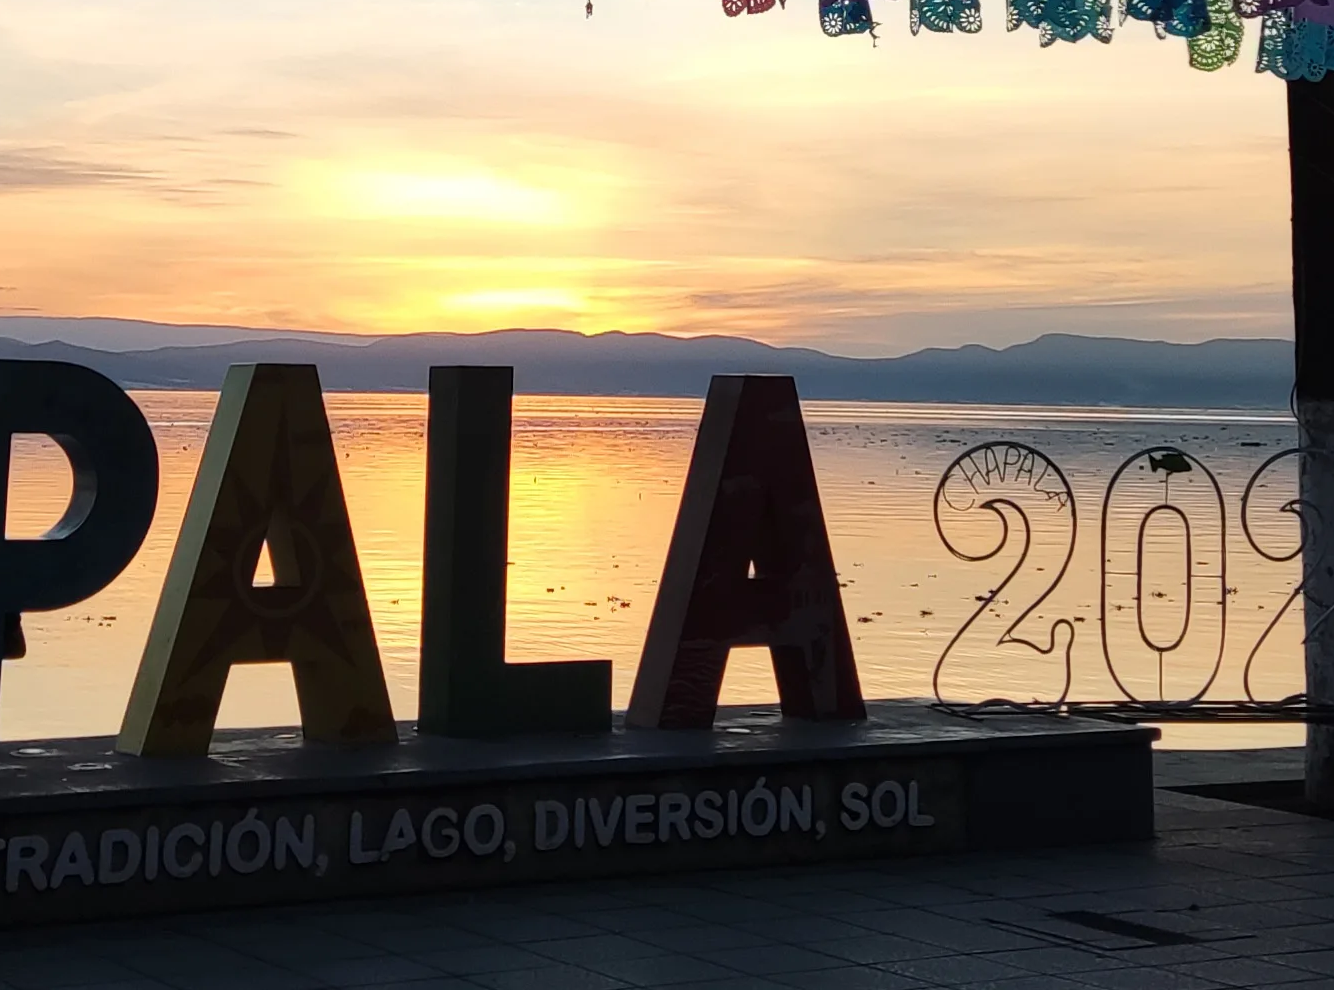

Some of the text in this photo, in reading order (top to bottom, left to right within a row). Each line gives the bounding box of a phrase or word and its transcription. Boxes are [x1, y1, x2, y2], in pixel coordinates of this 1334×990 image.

[942, 446, 1069, 512] CHAPALA
[348, 803, 517, 866] LAGO,
[533, 777, 826, 853] DIVERSIÓN,
[838, 779, 935, 831] SOL
